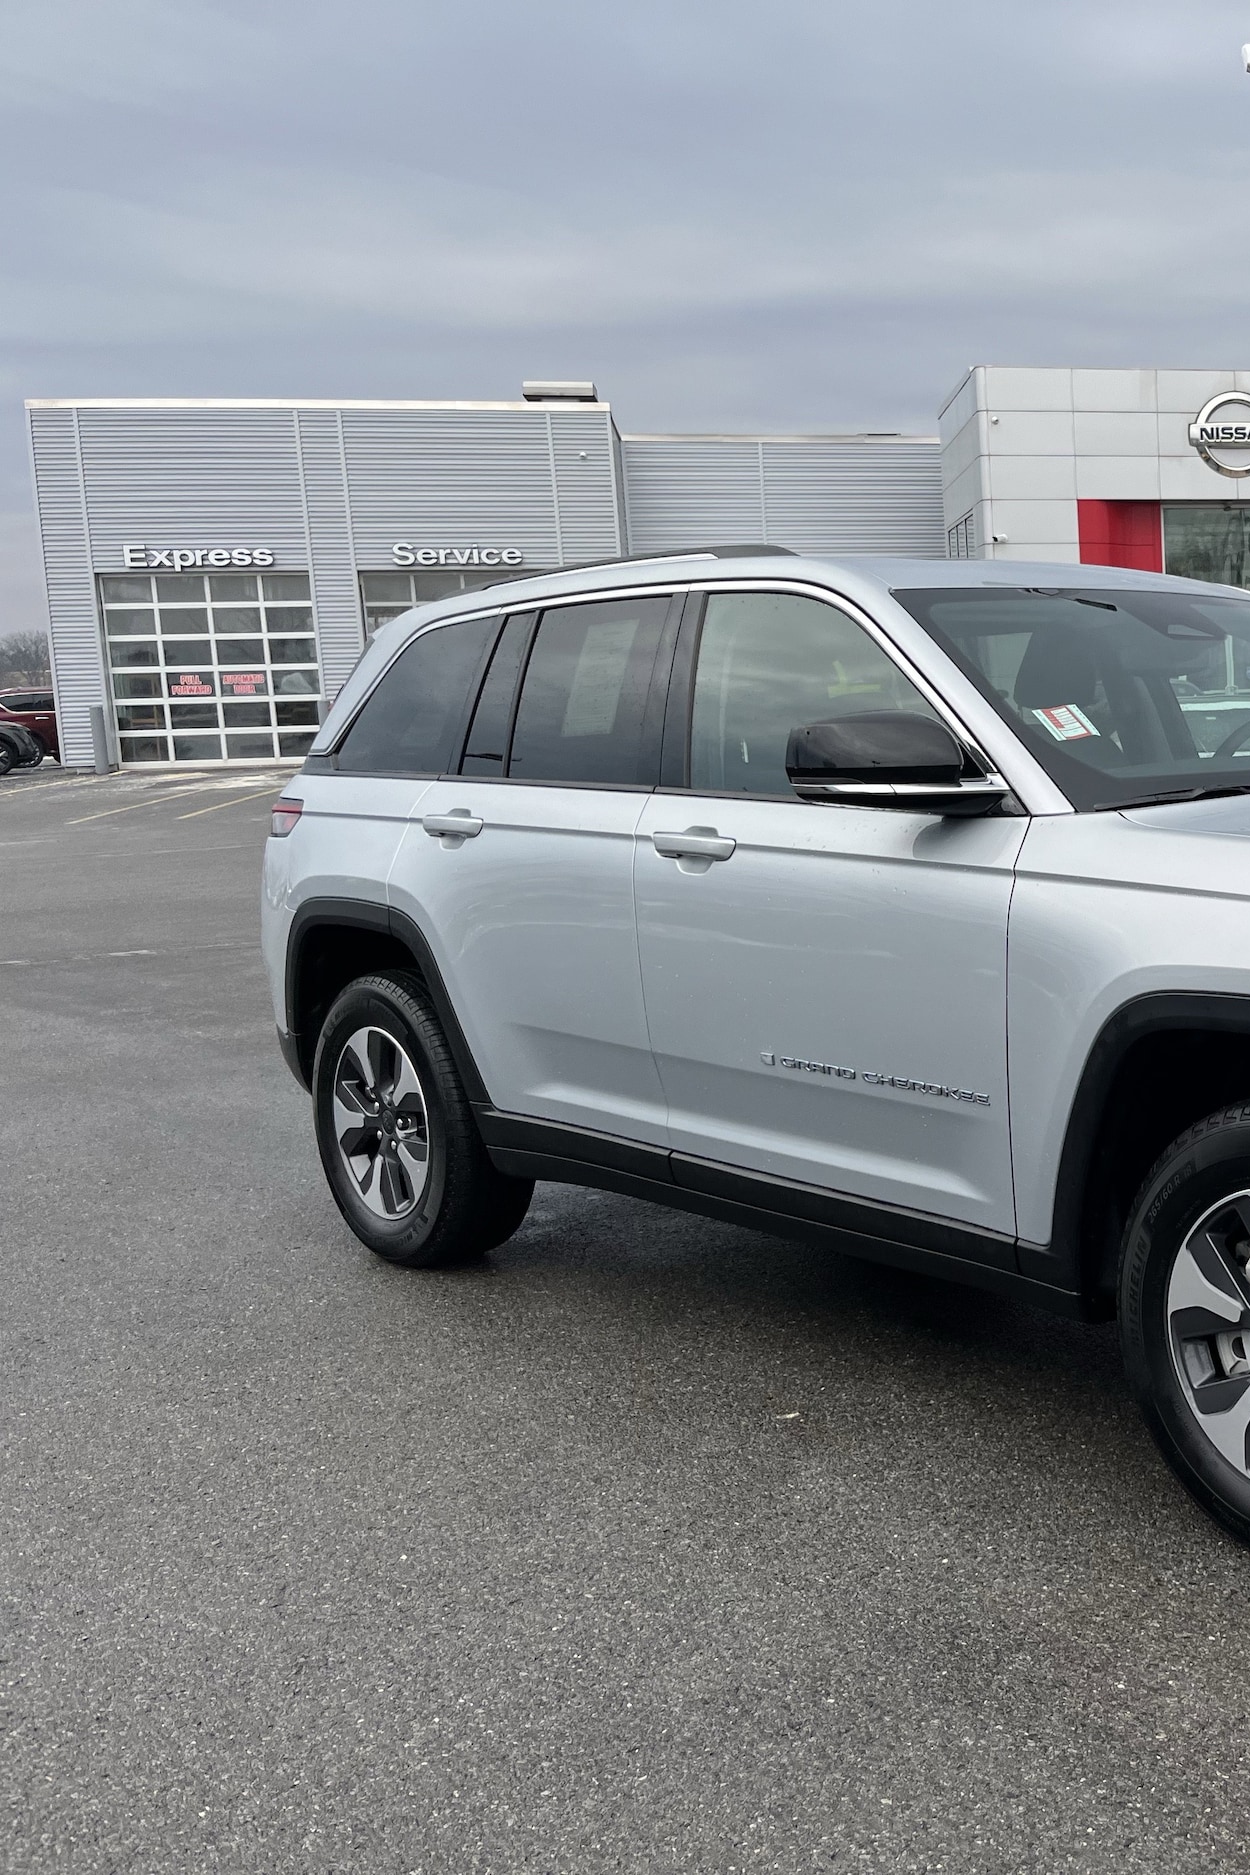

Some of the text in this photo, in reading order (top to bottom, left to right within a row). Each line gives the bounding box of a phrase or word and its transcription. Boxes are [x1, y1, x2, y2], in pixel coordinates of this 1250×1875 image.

[122, 542, 523, 572] Express Service
[179, 674, 203, 685] PULL
[222, 673, 265, 685] AUTOMATIC
[171, 684, 213, 696] FORWARD
[233, 684, 256, 695] DOOR
[780, 1056, 992, 1107] GRAND CHEROKEE
